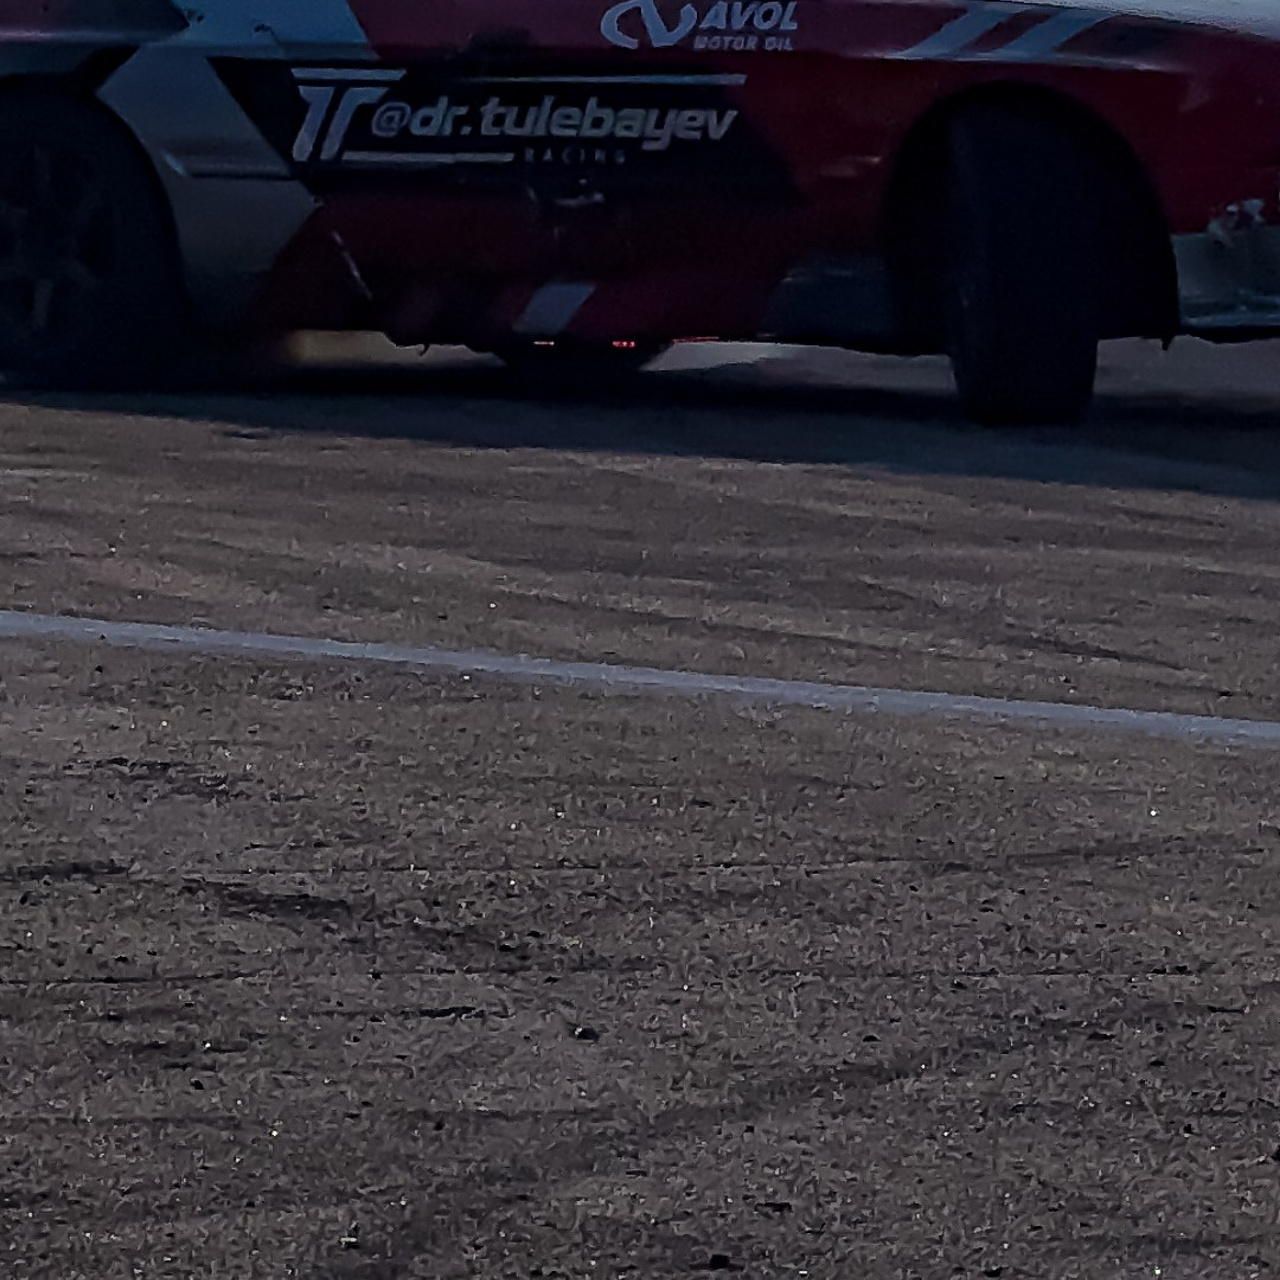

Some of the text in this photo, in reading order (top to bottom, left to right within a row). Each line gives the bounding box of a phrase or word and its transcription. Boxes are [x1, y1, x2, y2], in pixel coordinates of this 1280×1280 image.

[699, 0, 798, 30] AVOL
[693, 35, 794, 51] MOTOR OIL
[371, 94, 739, 152] @dr.tulebayev
